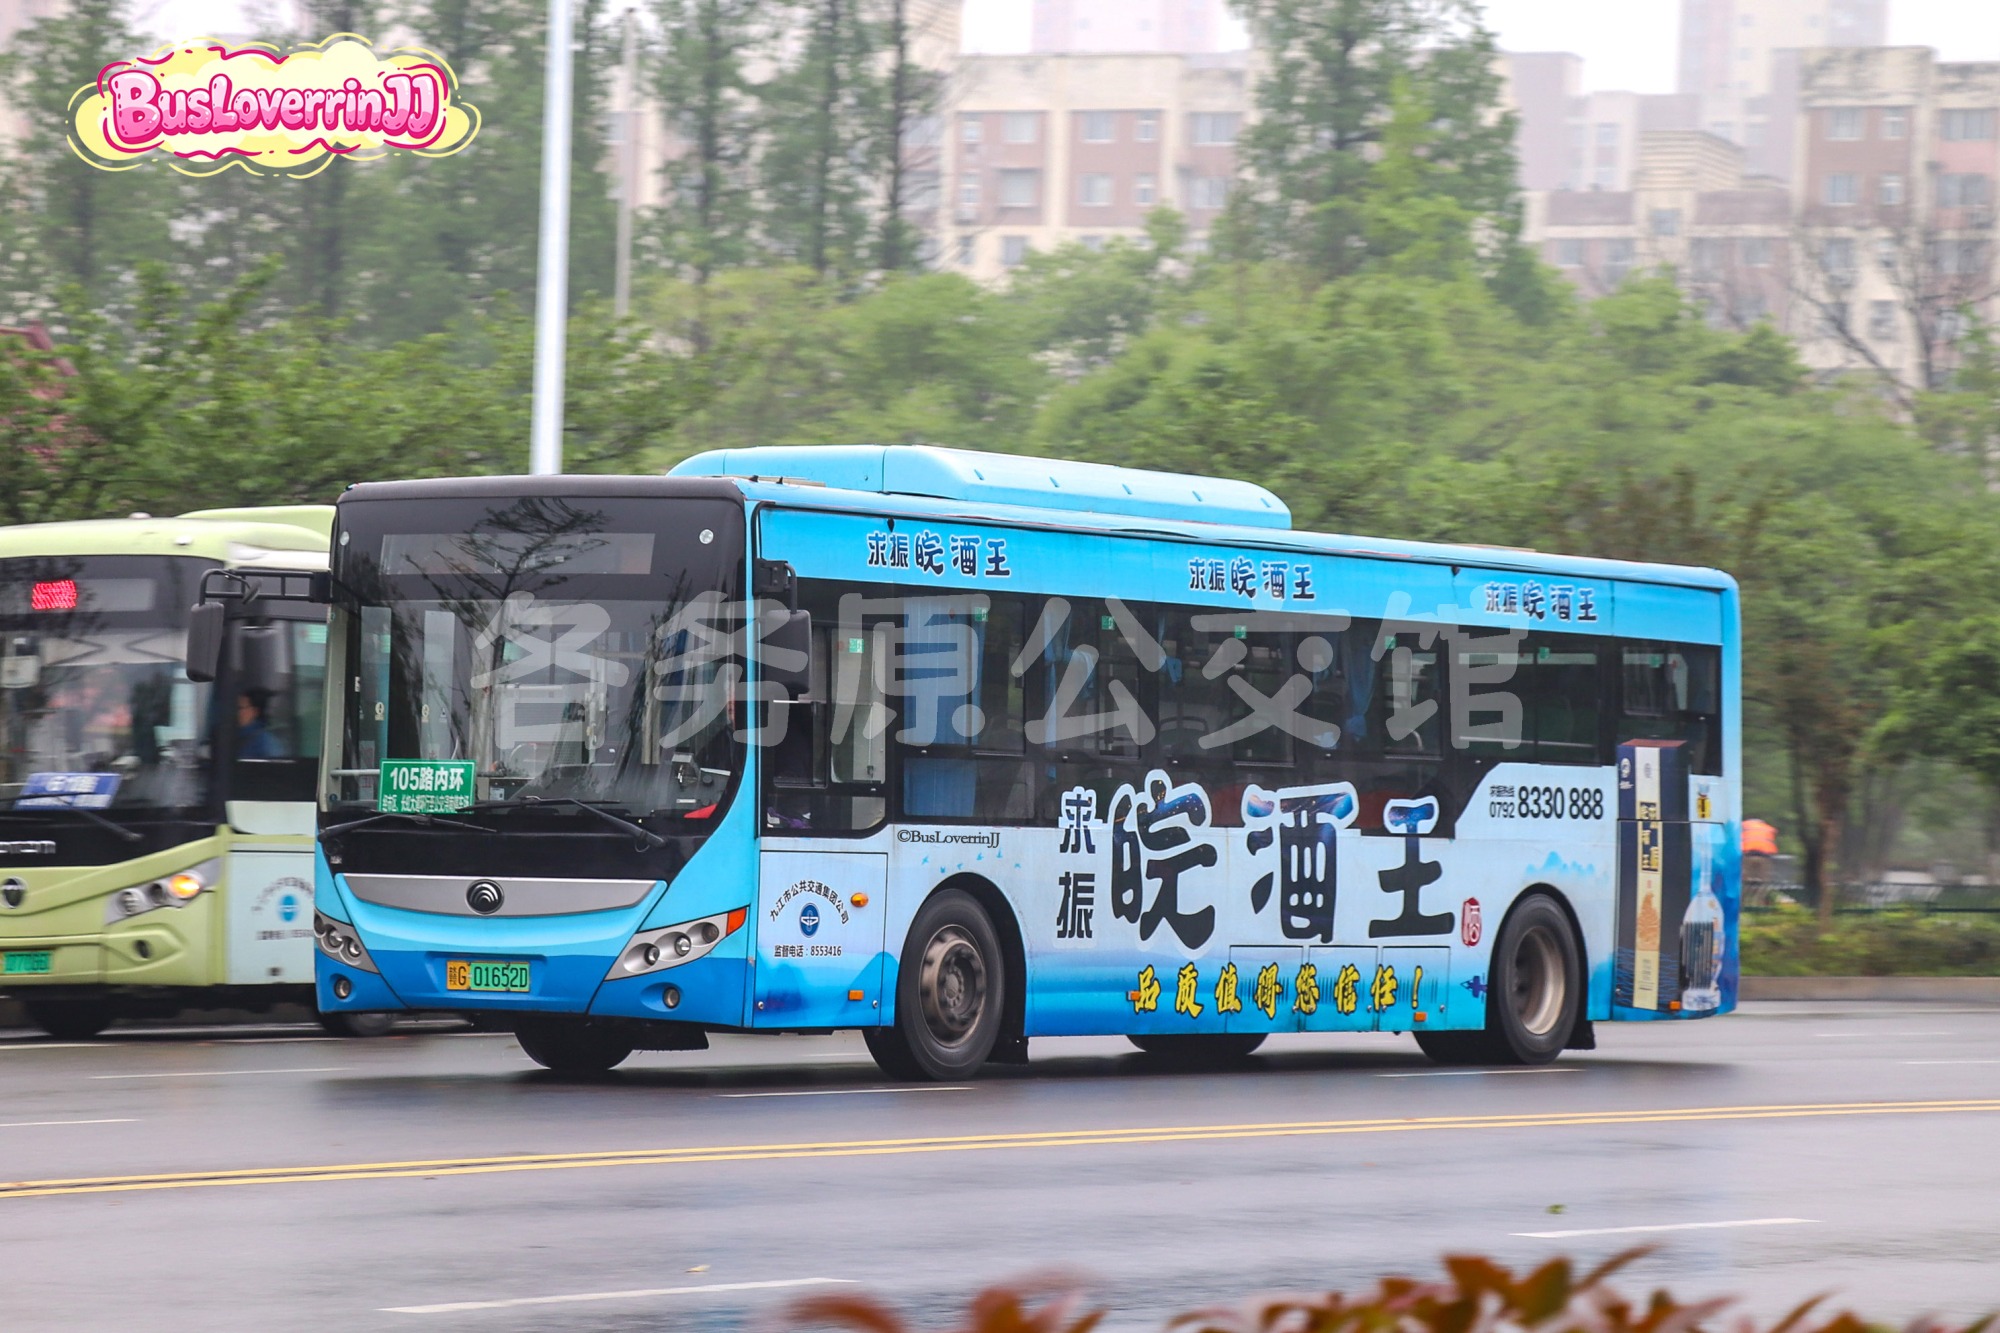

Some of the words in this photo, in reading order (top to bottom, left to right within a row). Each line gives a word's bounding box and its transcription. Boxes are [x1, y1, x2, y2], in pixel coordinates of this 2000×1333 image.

[867, 530, 1011, 577] 求振皖酒王
[1188, 555, 1316, 601] 求振皖酒王
[390, 766, 464, 792] 105路内环
[1489, 801, 1515, 818] 0792
[1518, 786, 1565, 819] 8330
[1569, 787, 1604, 820] 888
[769, 880, 850, 924] 九江市公共交通集团公司
